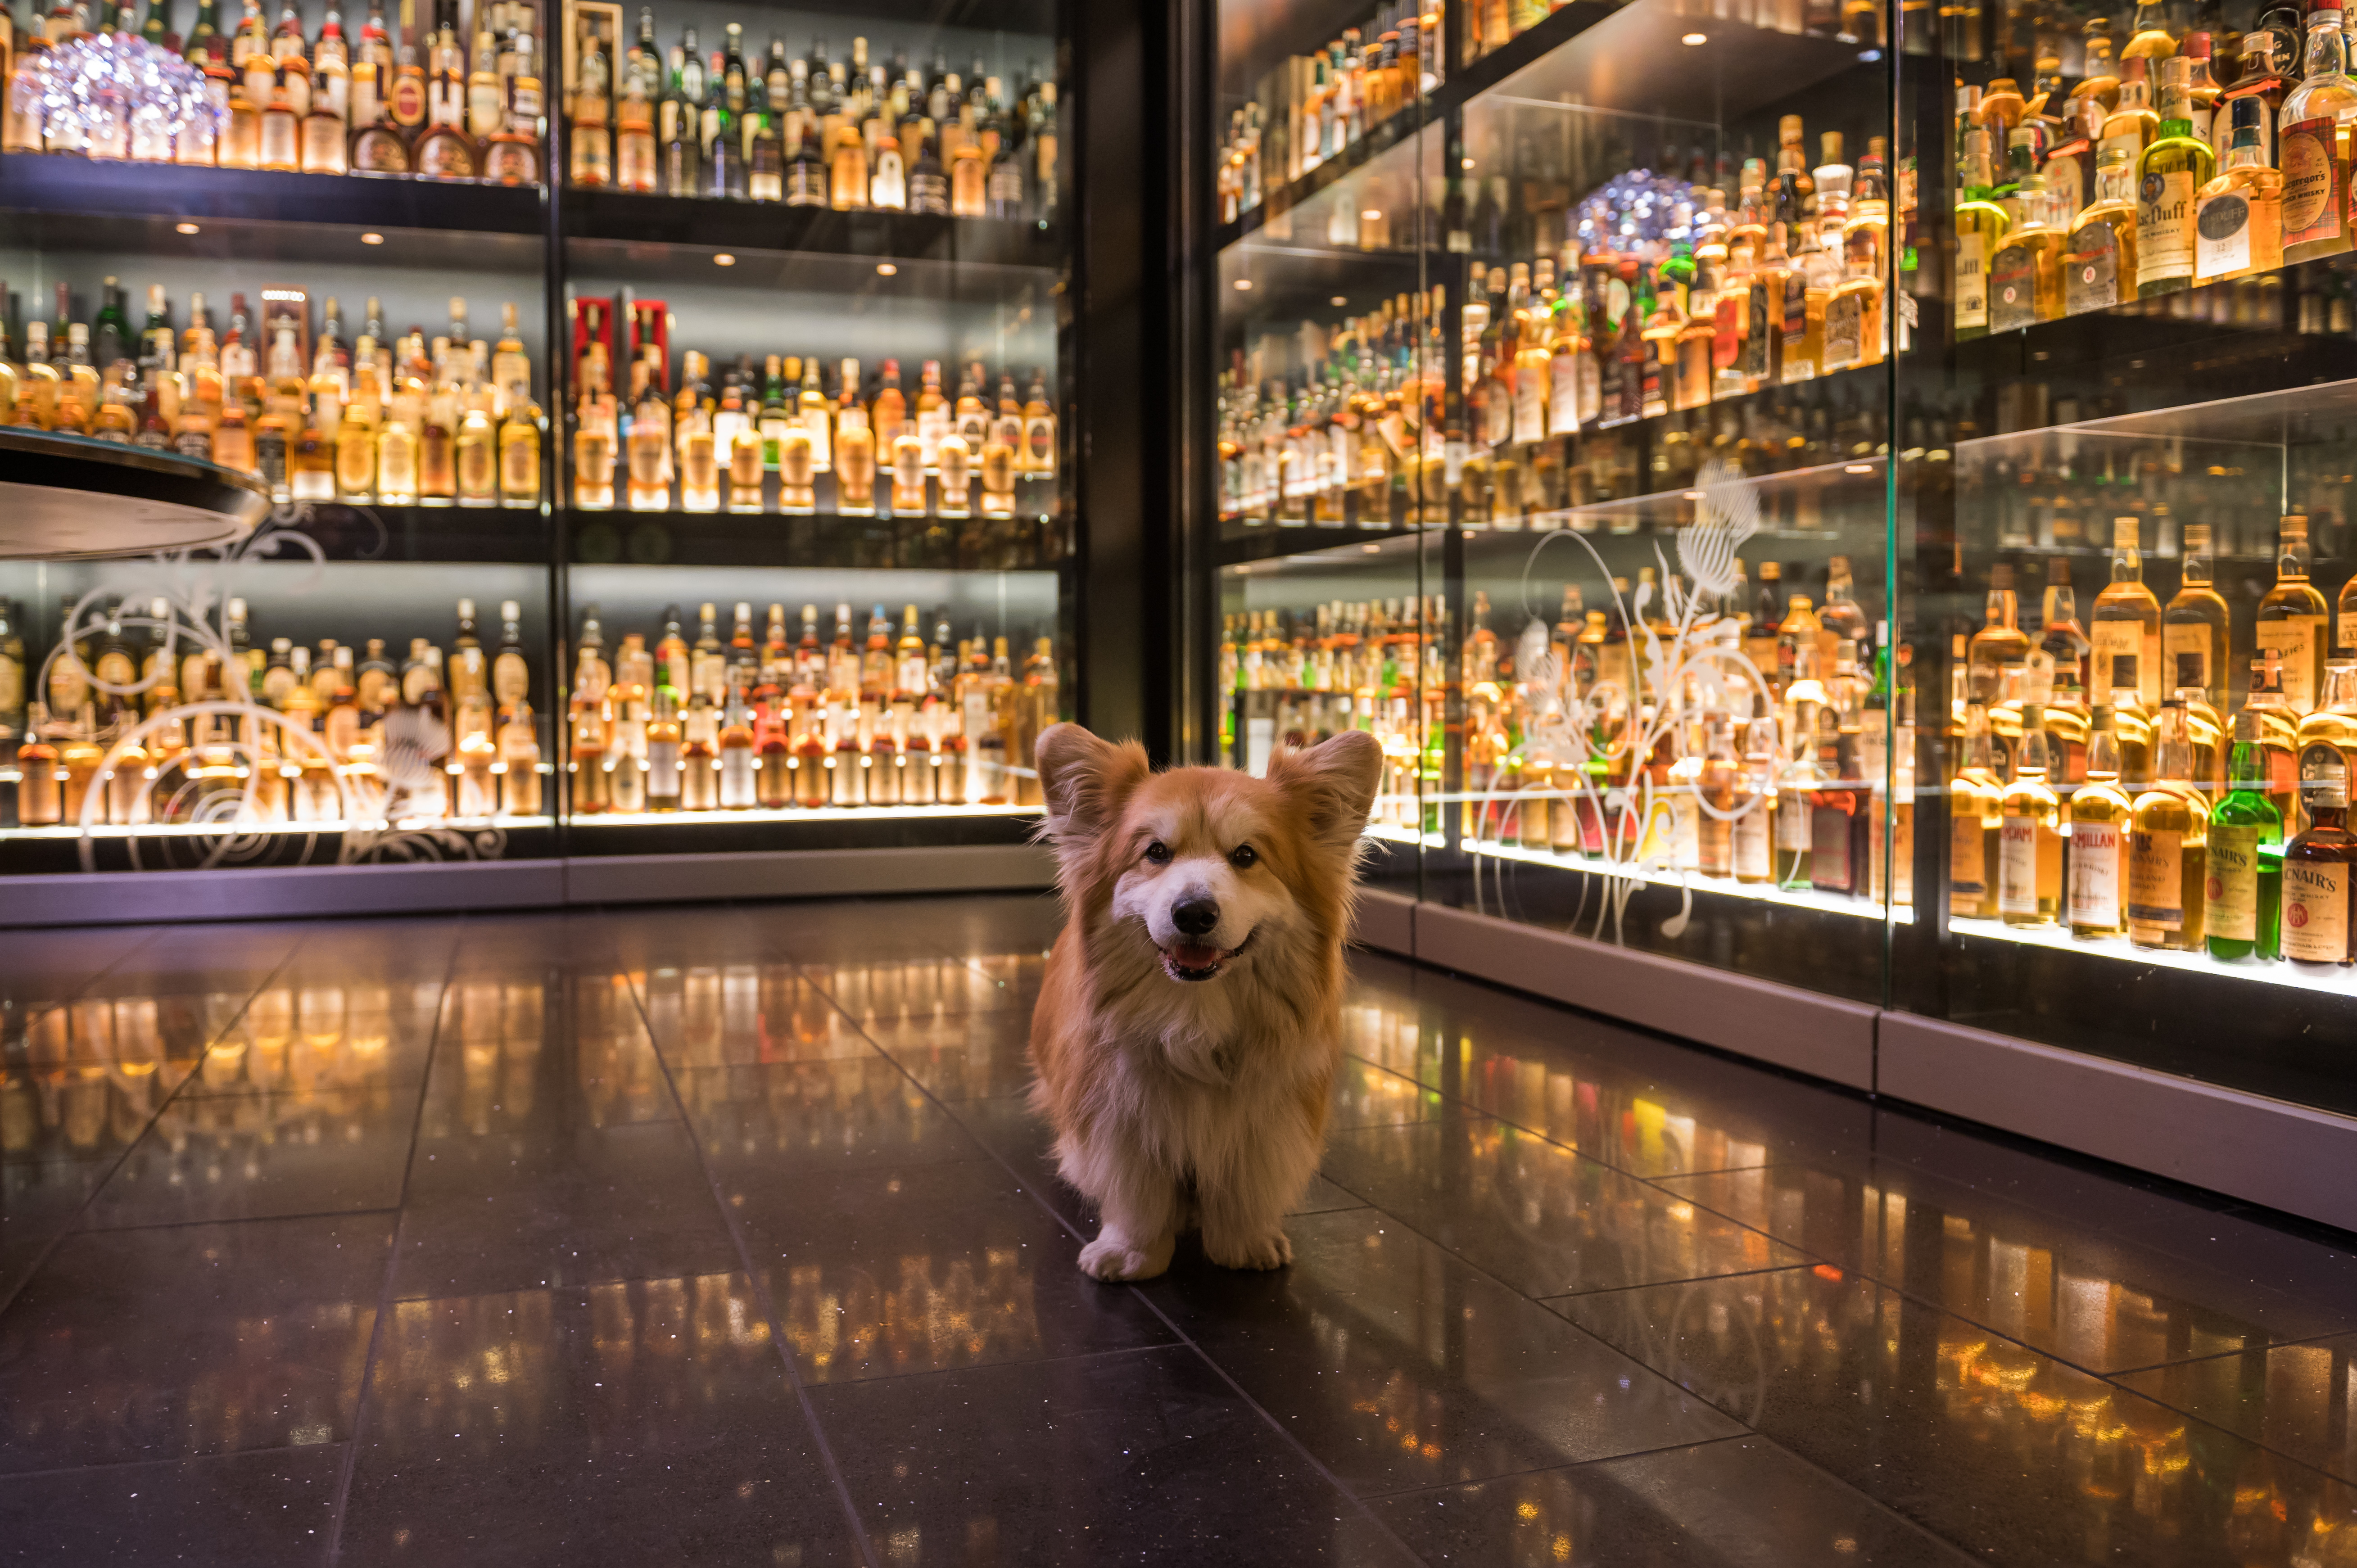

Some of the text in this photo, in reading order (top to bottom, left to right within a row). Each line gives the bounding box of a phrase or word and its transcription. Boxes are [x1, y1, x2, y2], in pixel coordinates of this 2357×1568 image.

[2281, 170, 2326, 191] acgregor's
[2298, 189, 2325, 200] WHISKY
[2137, 200, 2187, 226] acDuff
